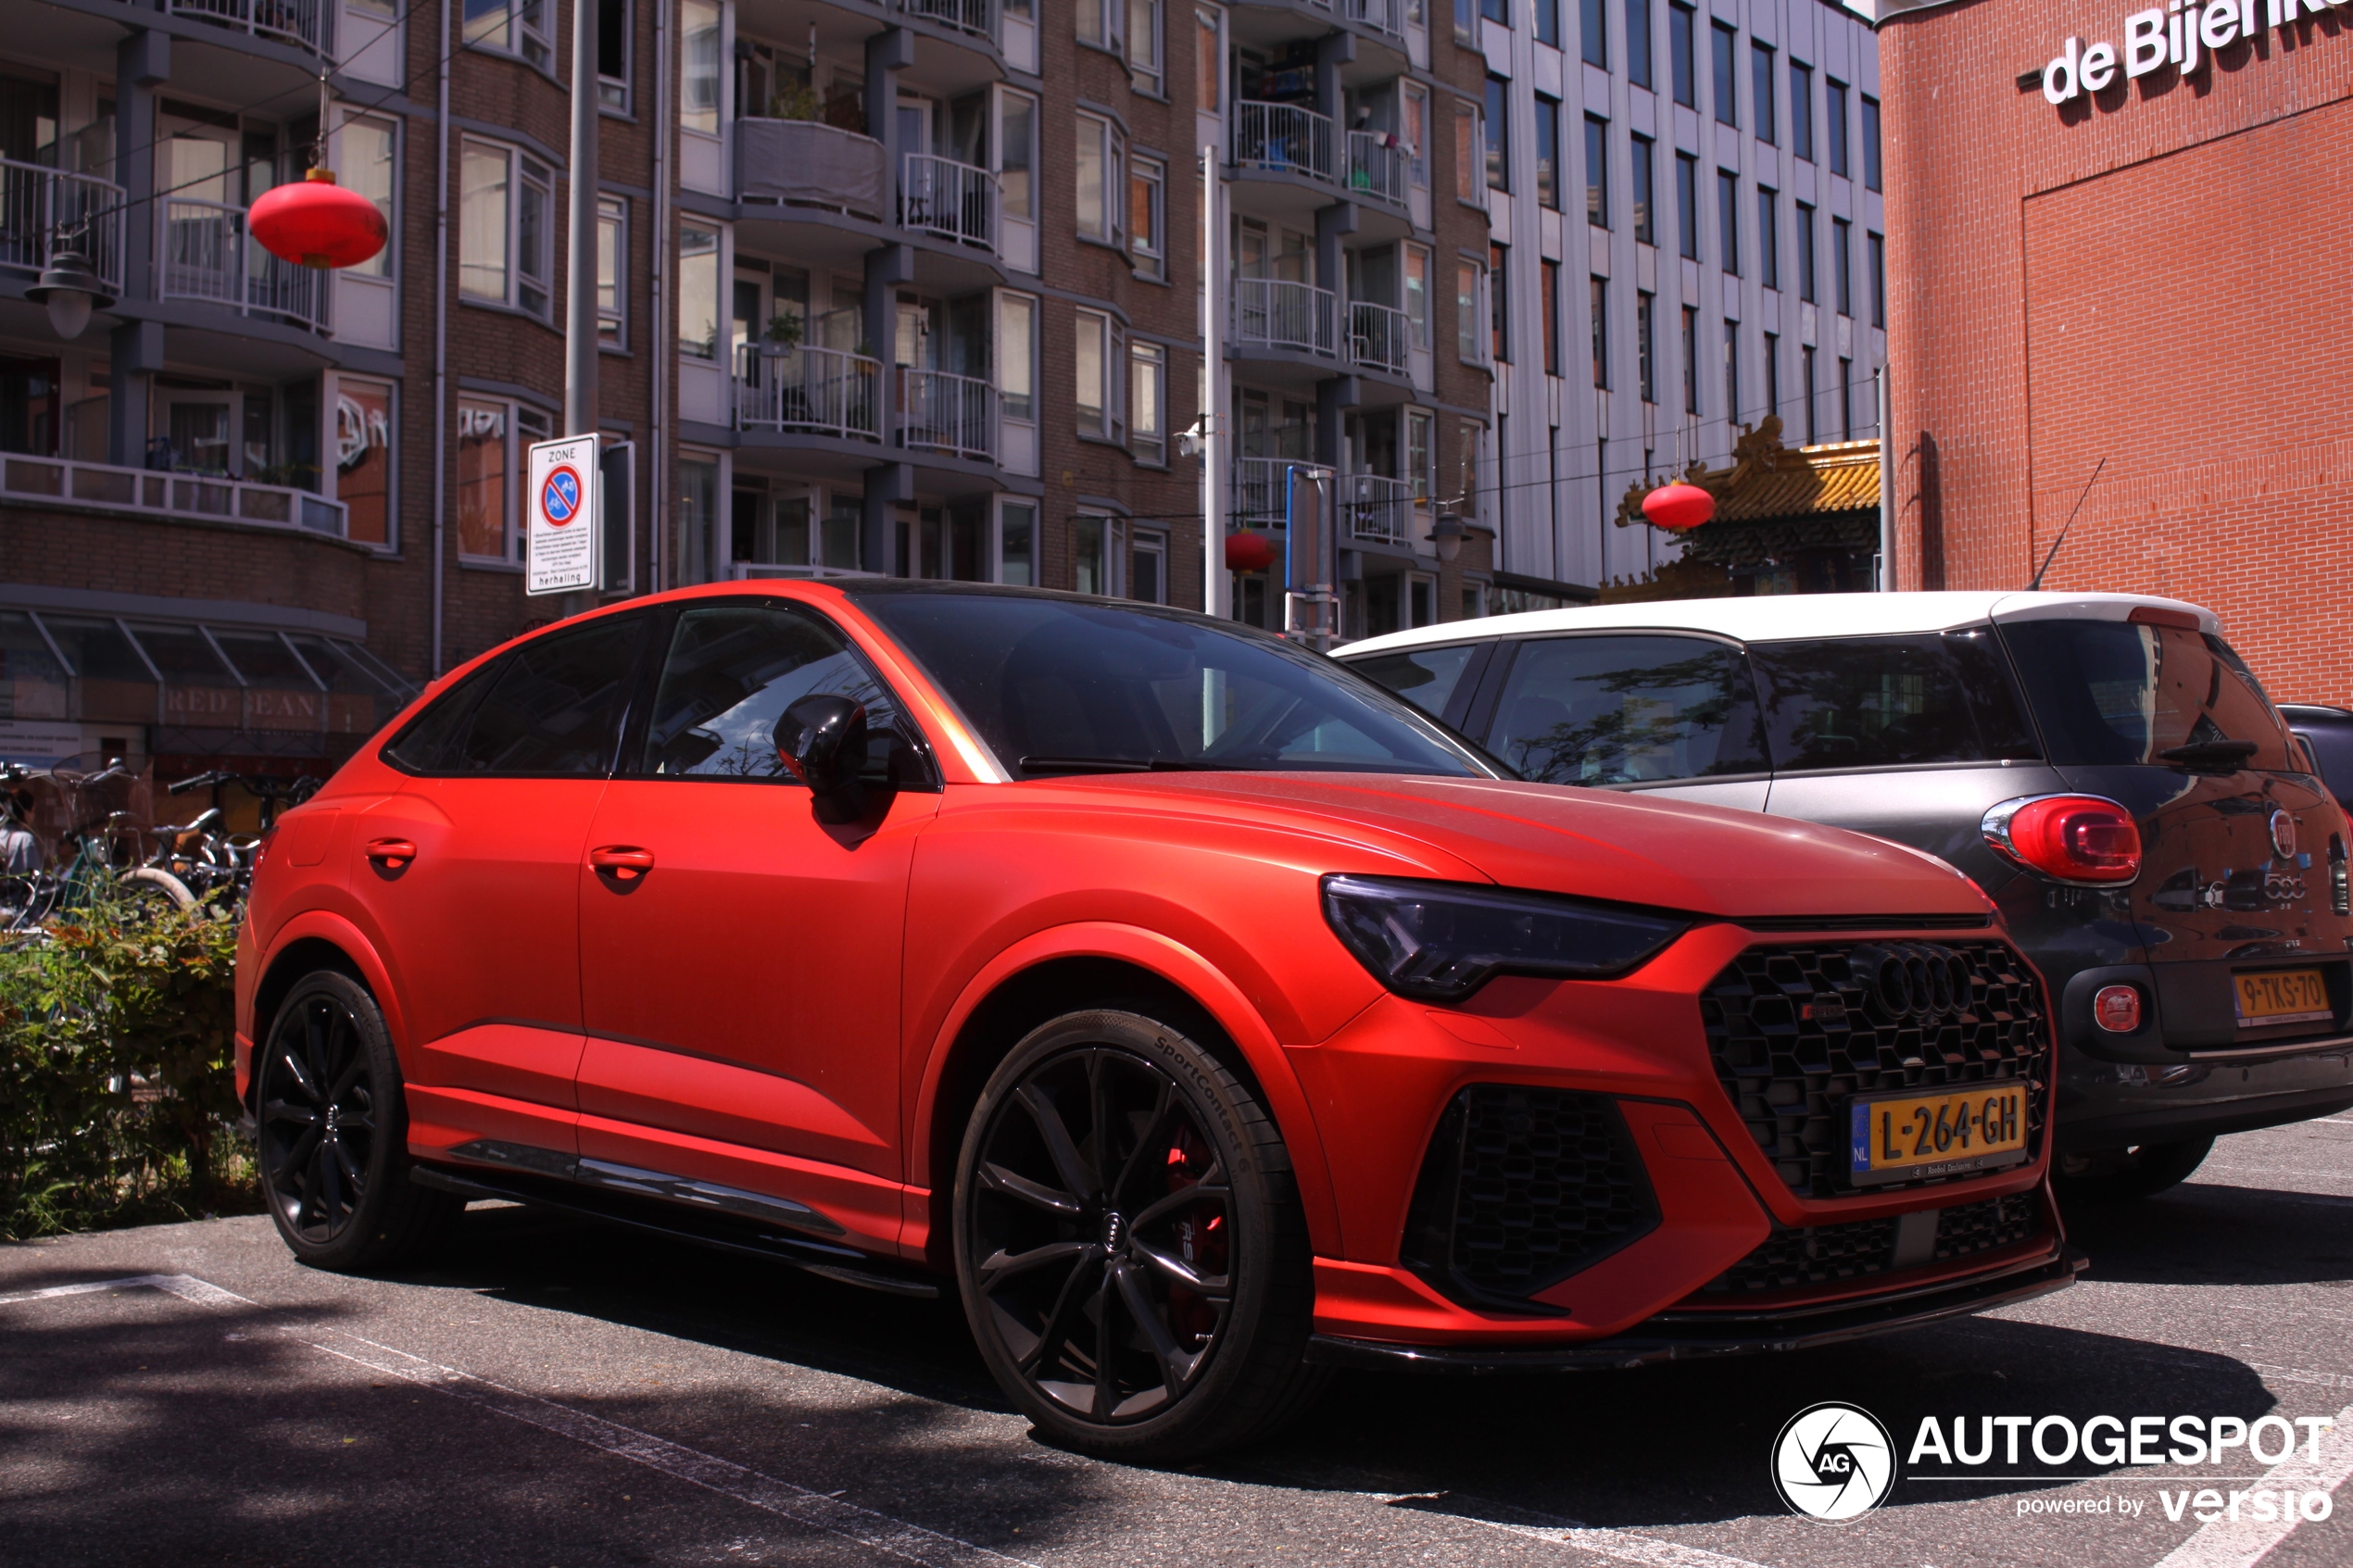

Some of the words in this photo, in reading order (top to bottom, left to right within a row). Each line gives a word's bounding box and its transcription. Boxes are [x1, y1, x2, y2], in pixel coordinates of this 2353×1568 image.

[2043, 37, 2120, 105] de
[548, 447, 576, 463] ZONE
[539, 572, 581, 586] herhaling
[167, 689, 228, 713] RED
[2244, 973, 2322, 1011] 9-TKS-70
[1153, 1035, 1244, 1154] SportContact
[1238, 1157, 1252, 1173] 6
[1882, 1096, 2019, 1160] L-264-GH
[1854, 1147, 1869, 1163] NL
